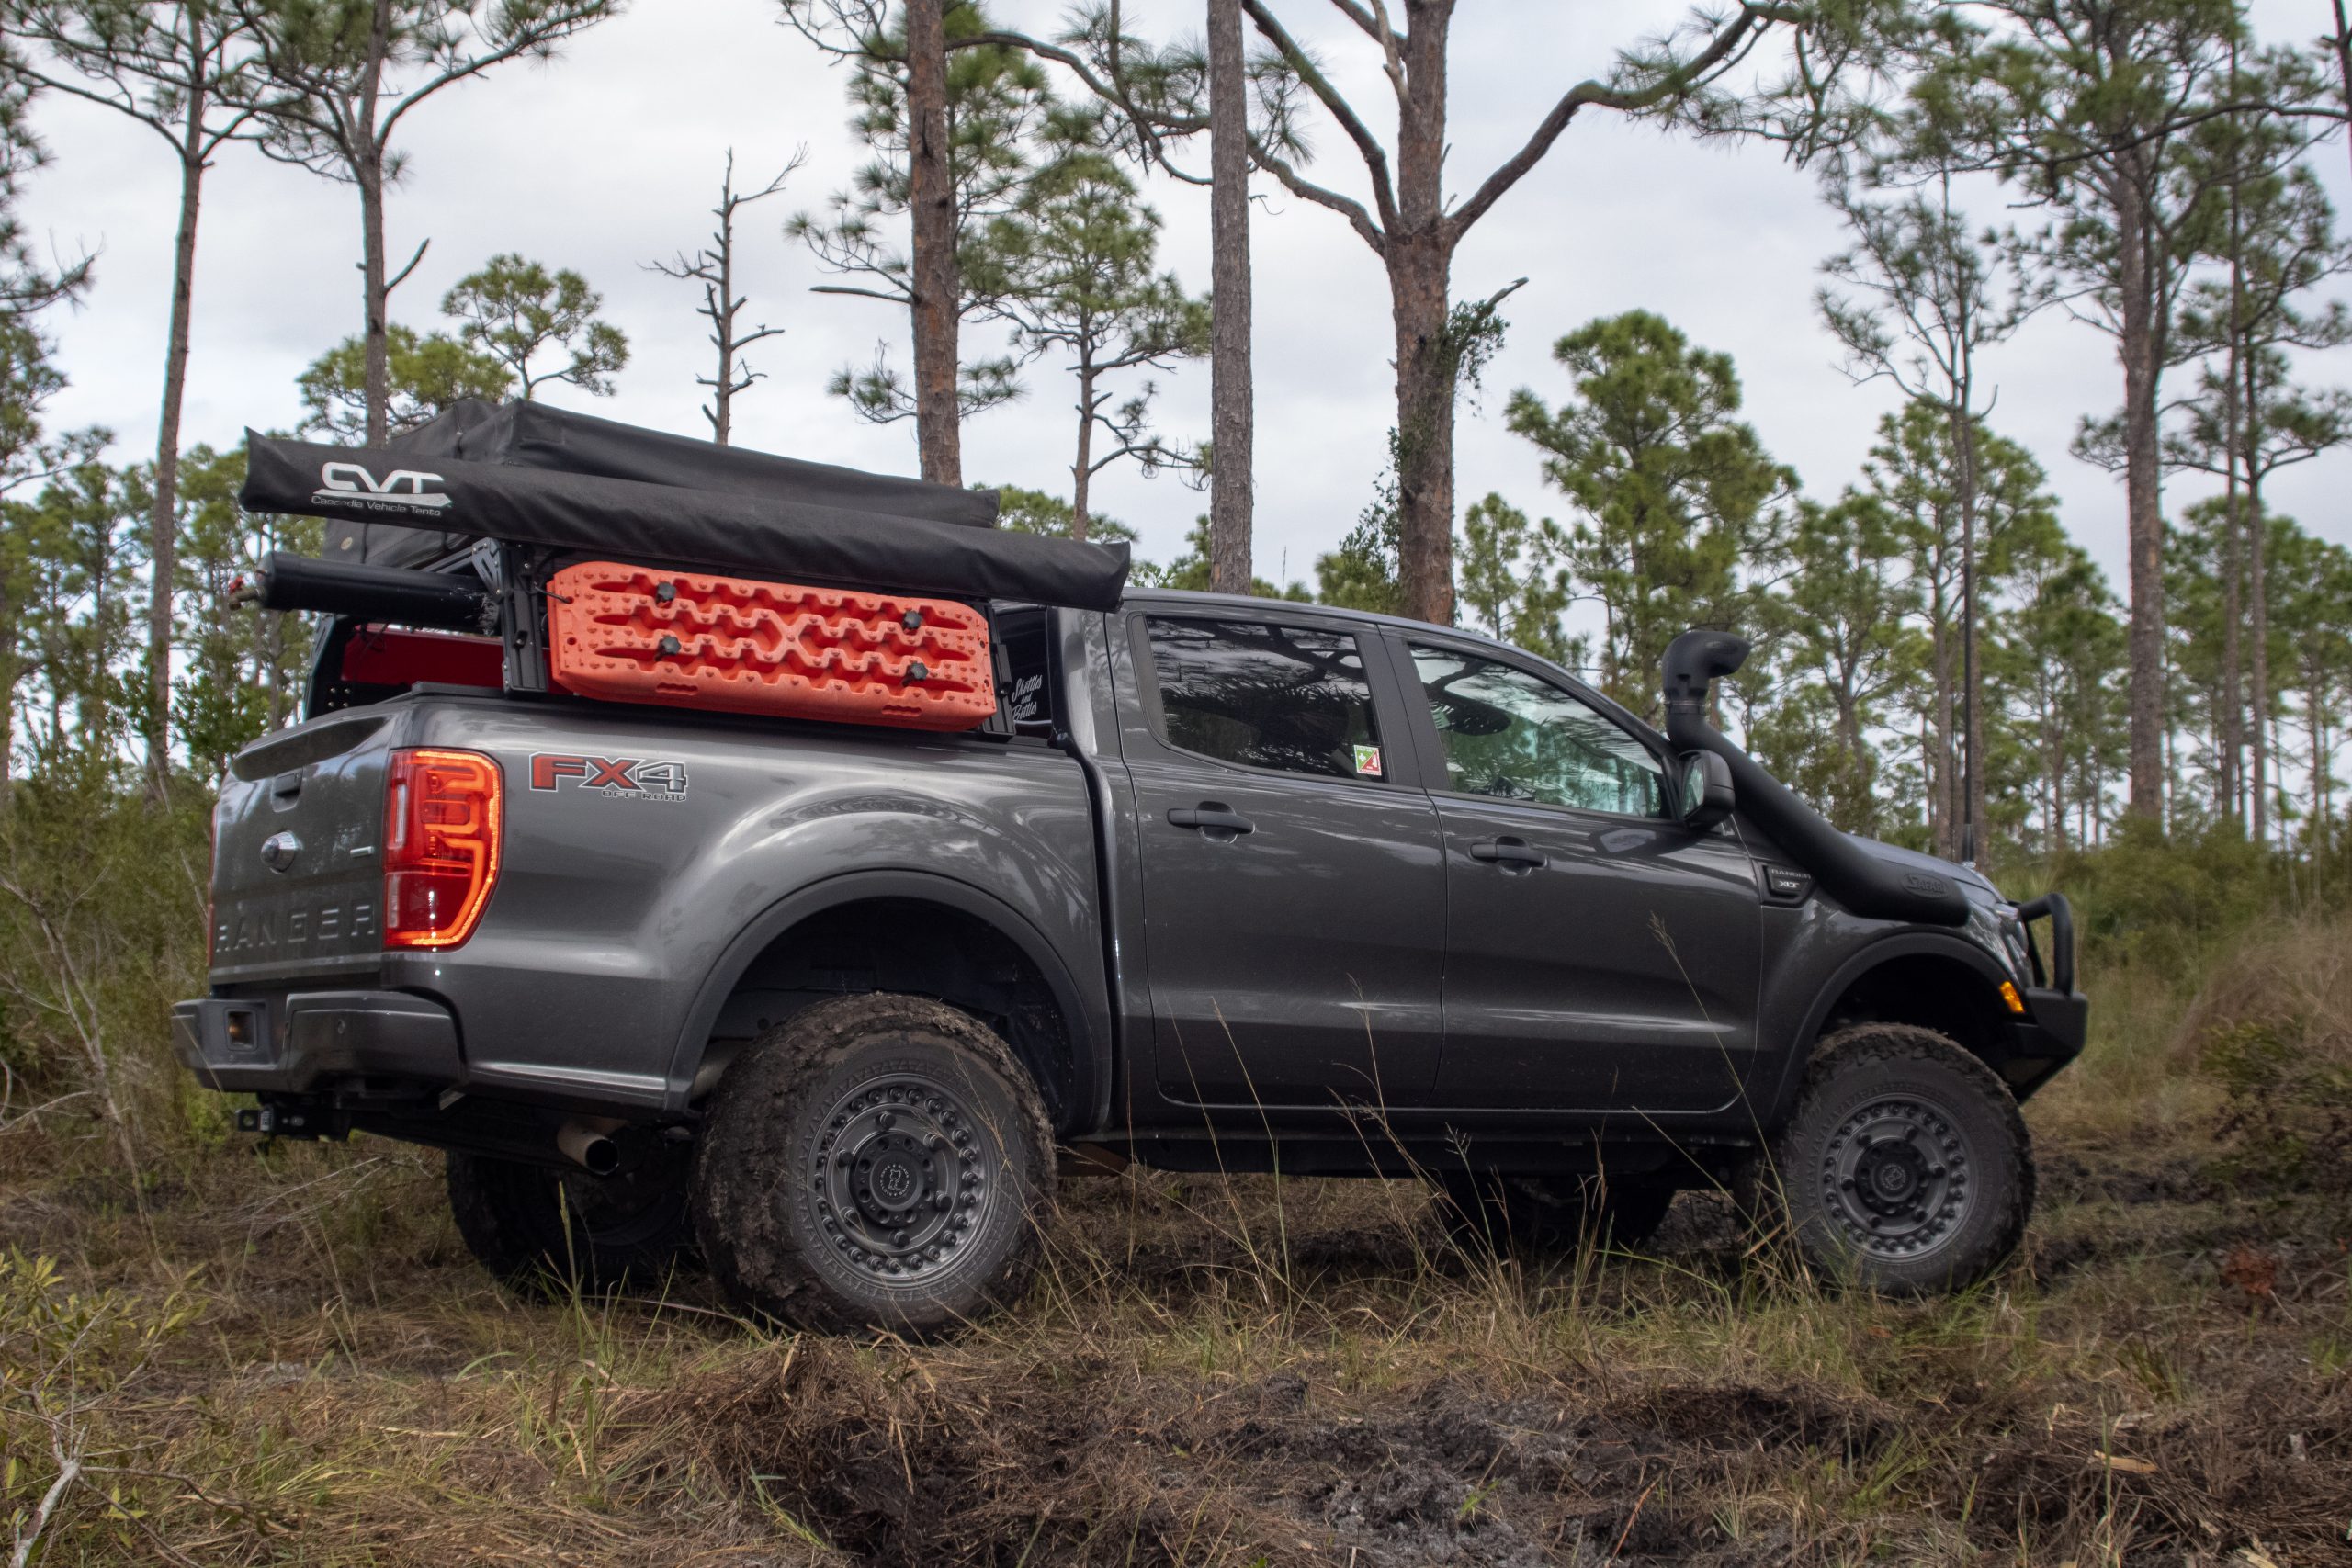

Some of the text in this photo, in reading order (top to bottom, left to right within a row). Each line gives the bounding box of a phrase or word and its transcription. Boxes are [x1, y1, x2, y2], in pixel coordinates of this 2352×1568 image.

[322, 462, 444, 493] CVT
[367, 501, 407, 513] Vehicle
[410, 505, 441, 516] Tents
[1020, 691, 1033, 705] and
[1011, 701, 1037, 721] Bottles
[529, 751, 688, 795] FX4
[602, 789, 687, 802] OFF ROAD
[1770, 868, 1812, 880] RANGER
[1779, 880, 1800, 888] XLT
[1905, 874, 1949, 893] SAFARI
[214, 902, 375, 953] RANGER
